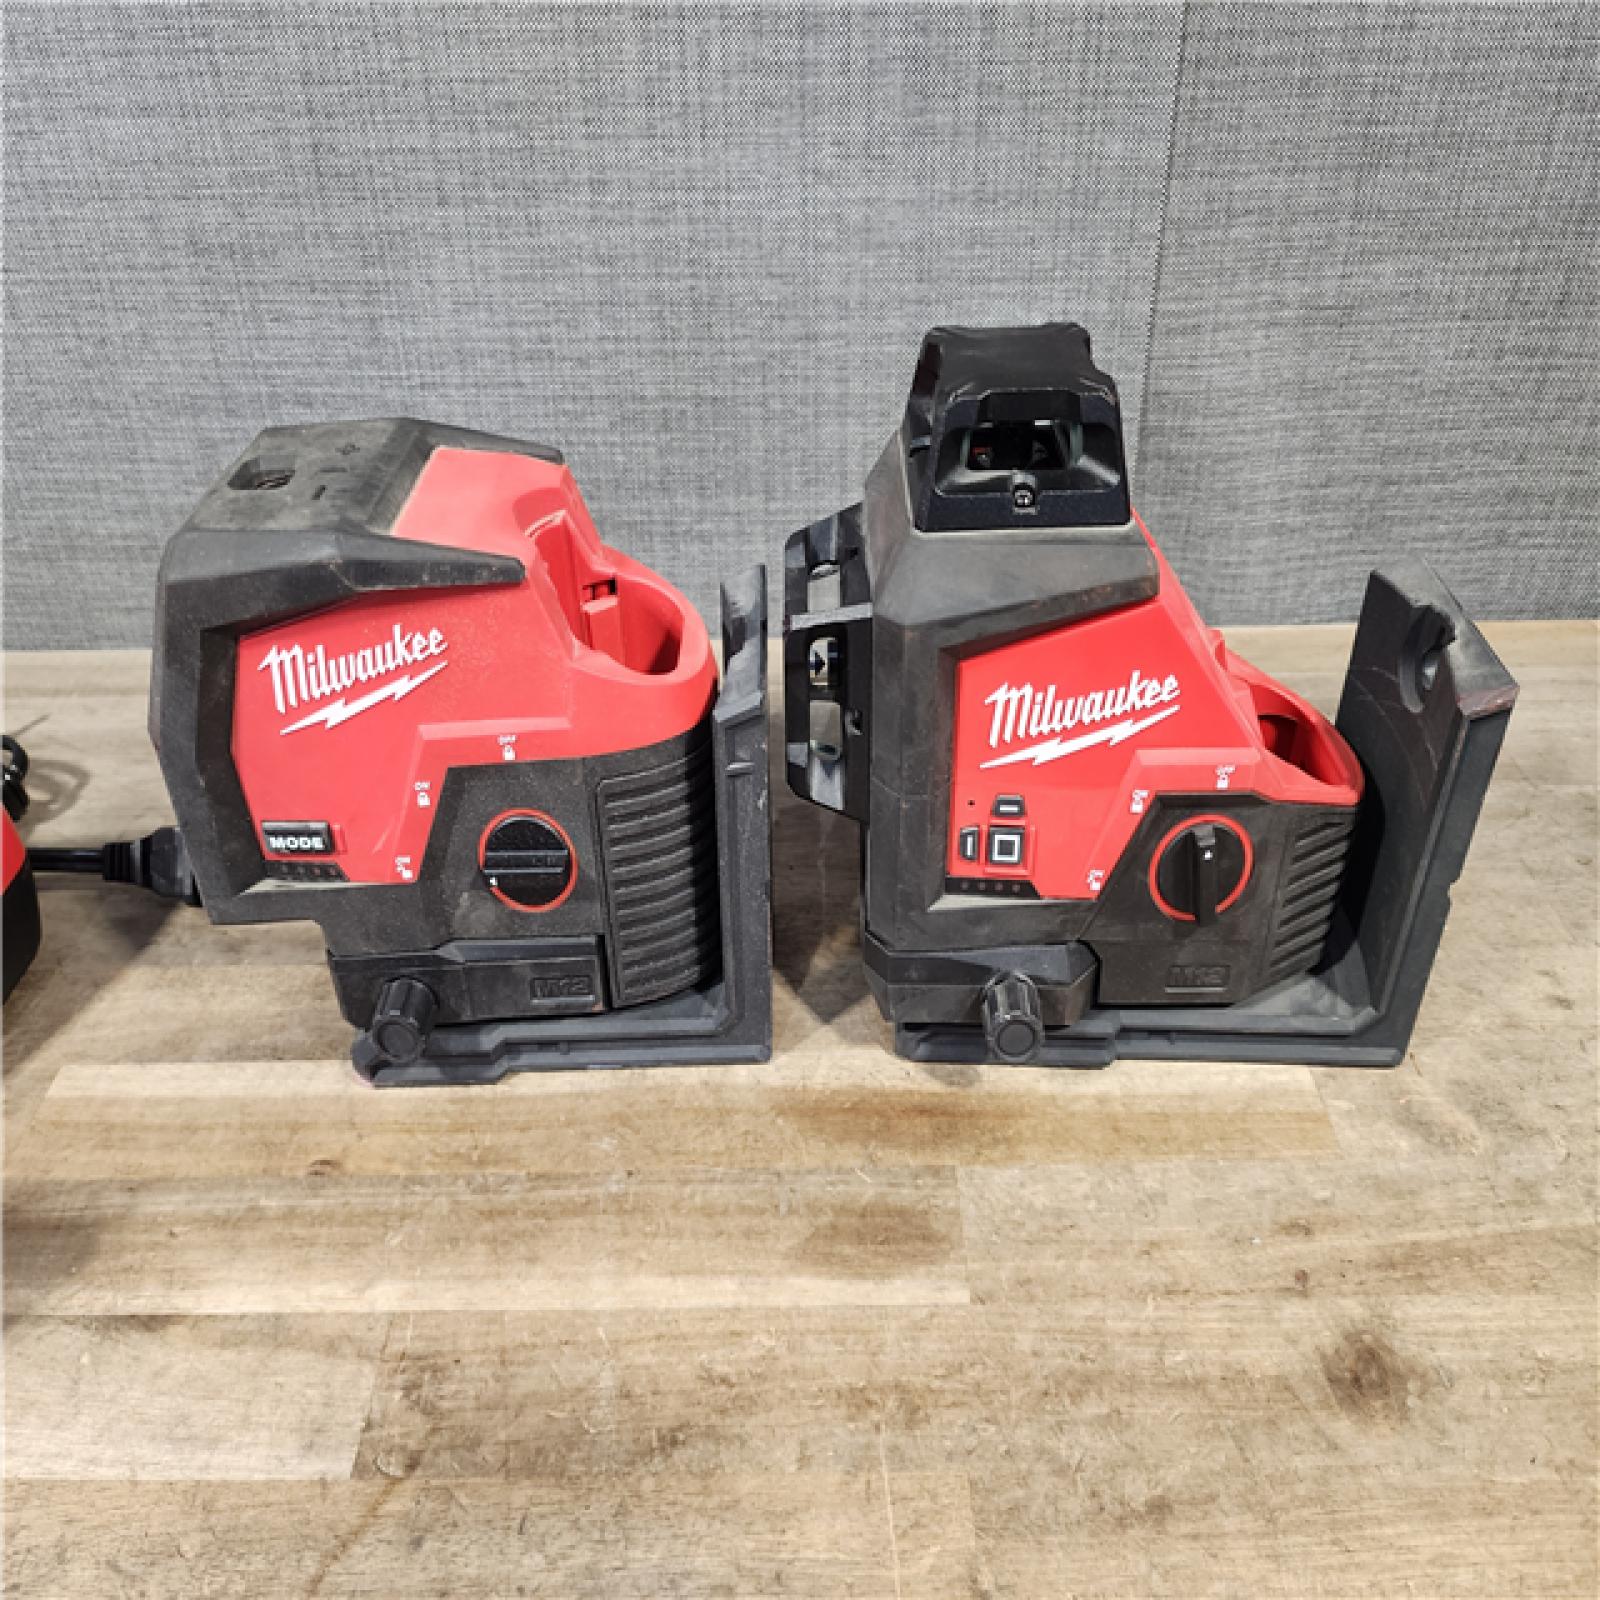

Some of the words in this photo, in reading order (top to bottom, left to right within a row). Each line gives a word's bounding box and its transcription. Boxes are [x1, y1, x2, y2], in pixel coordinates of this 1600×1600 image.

[257, 623, 448, 714] Milwaukee
[984, 669, 1181, 748] Milwaukee
[269, 835, 324, 850] MODE
